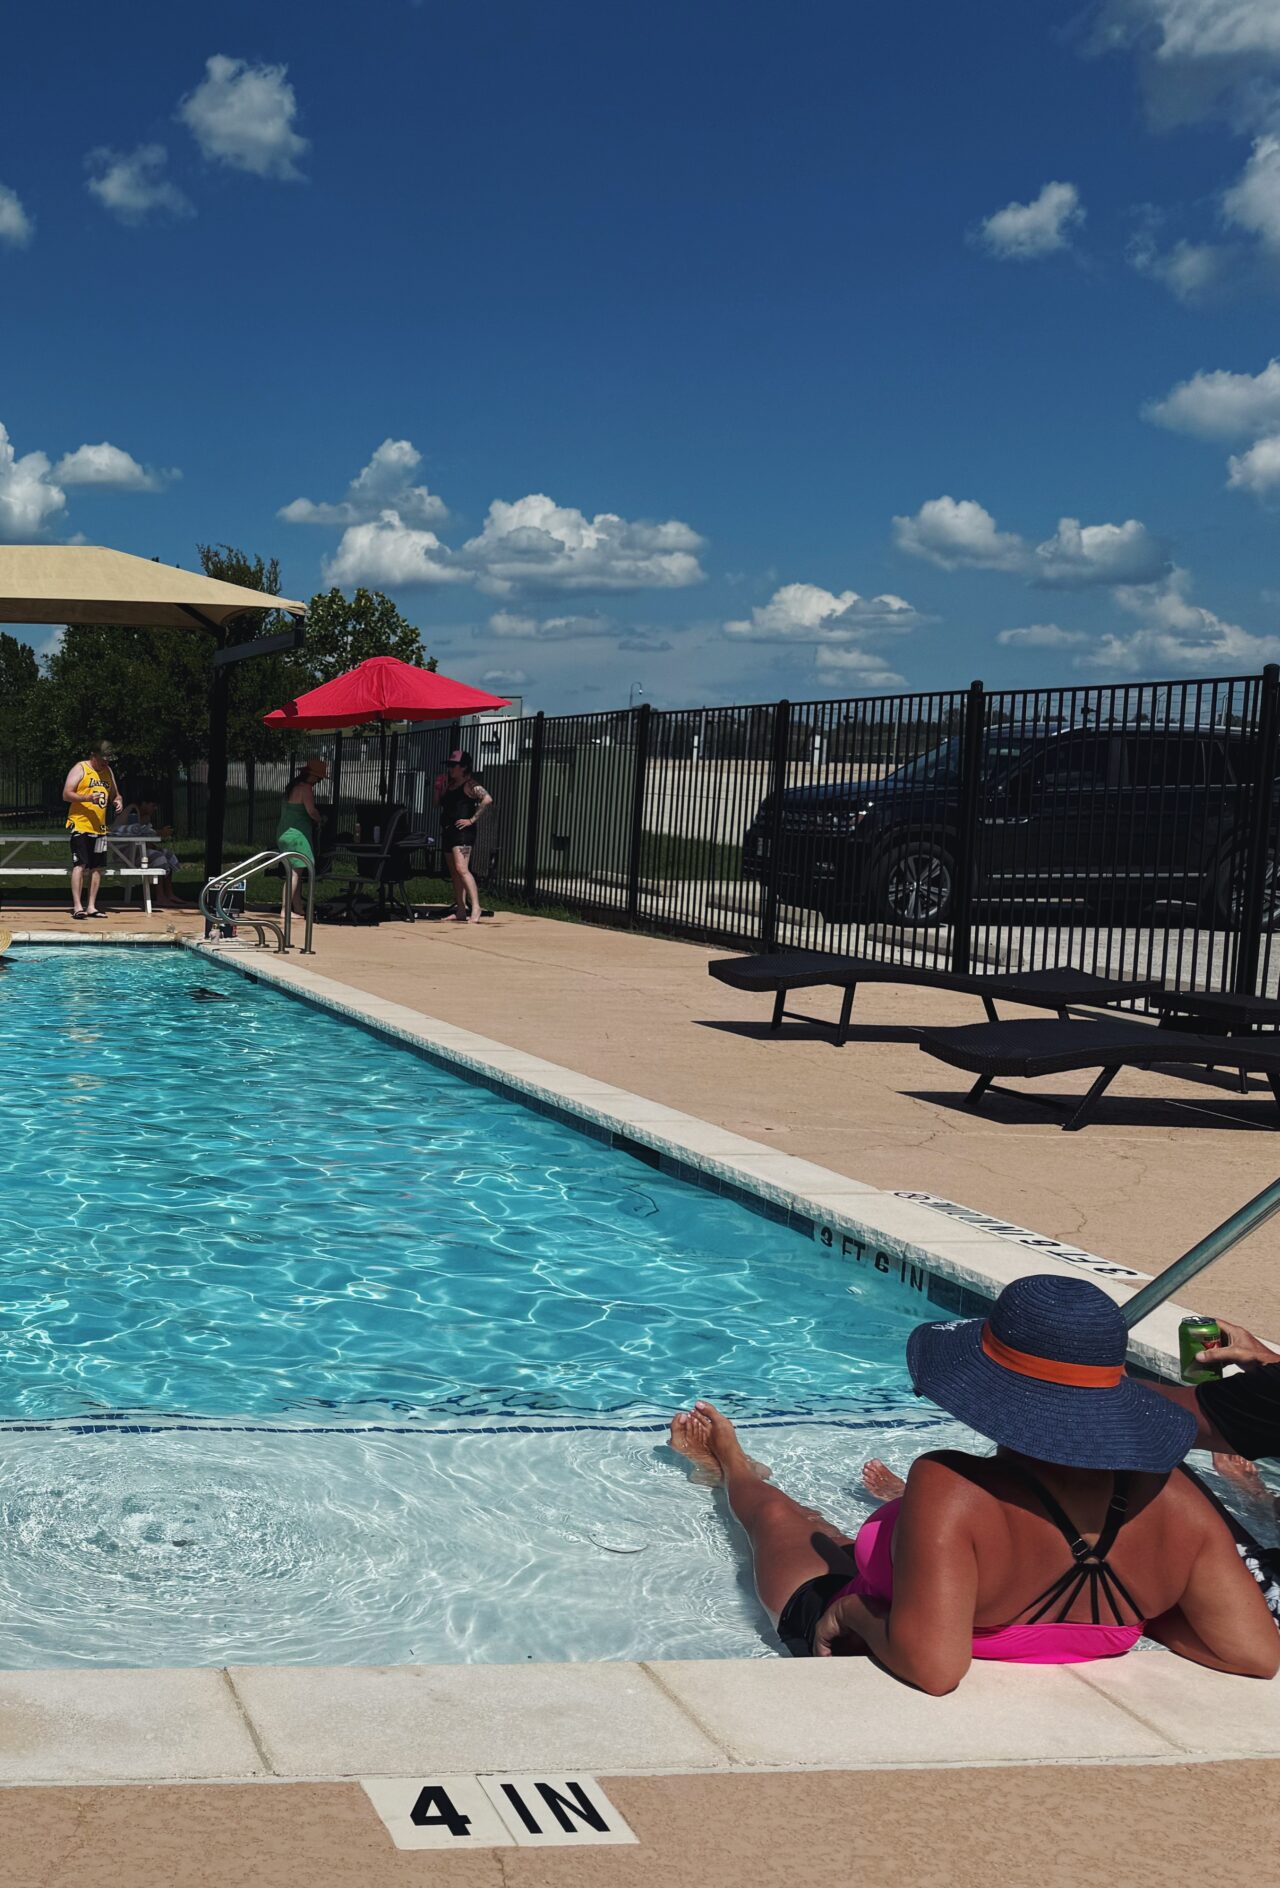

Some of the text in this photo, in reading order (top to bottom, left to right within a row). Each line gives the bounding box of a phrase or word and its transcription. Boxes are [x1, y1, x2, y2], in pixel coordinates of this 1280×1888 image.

[979, 1225, 1035, 1236] IN
[1019, 1239, 1061, 1247] 6
[820, 1226, 833, 1248] 3
[842, 1234, 866, 1262] FT
[901, 1261, 924, 1292] IN
[1046, 1250, 1109, 1264] FT
[1093, 1267, 1138, 1276] 3
[409, 1782, 611, 1836] 4 IN
